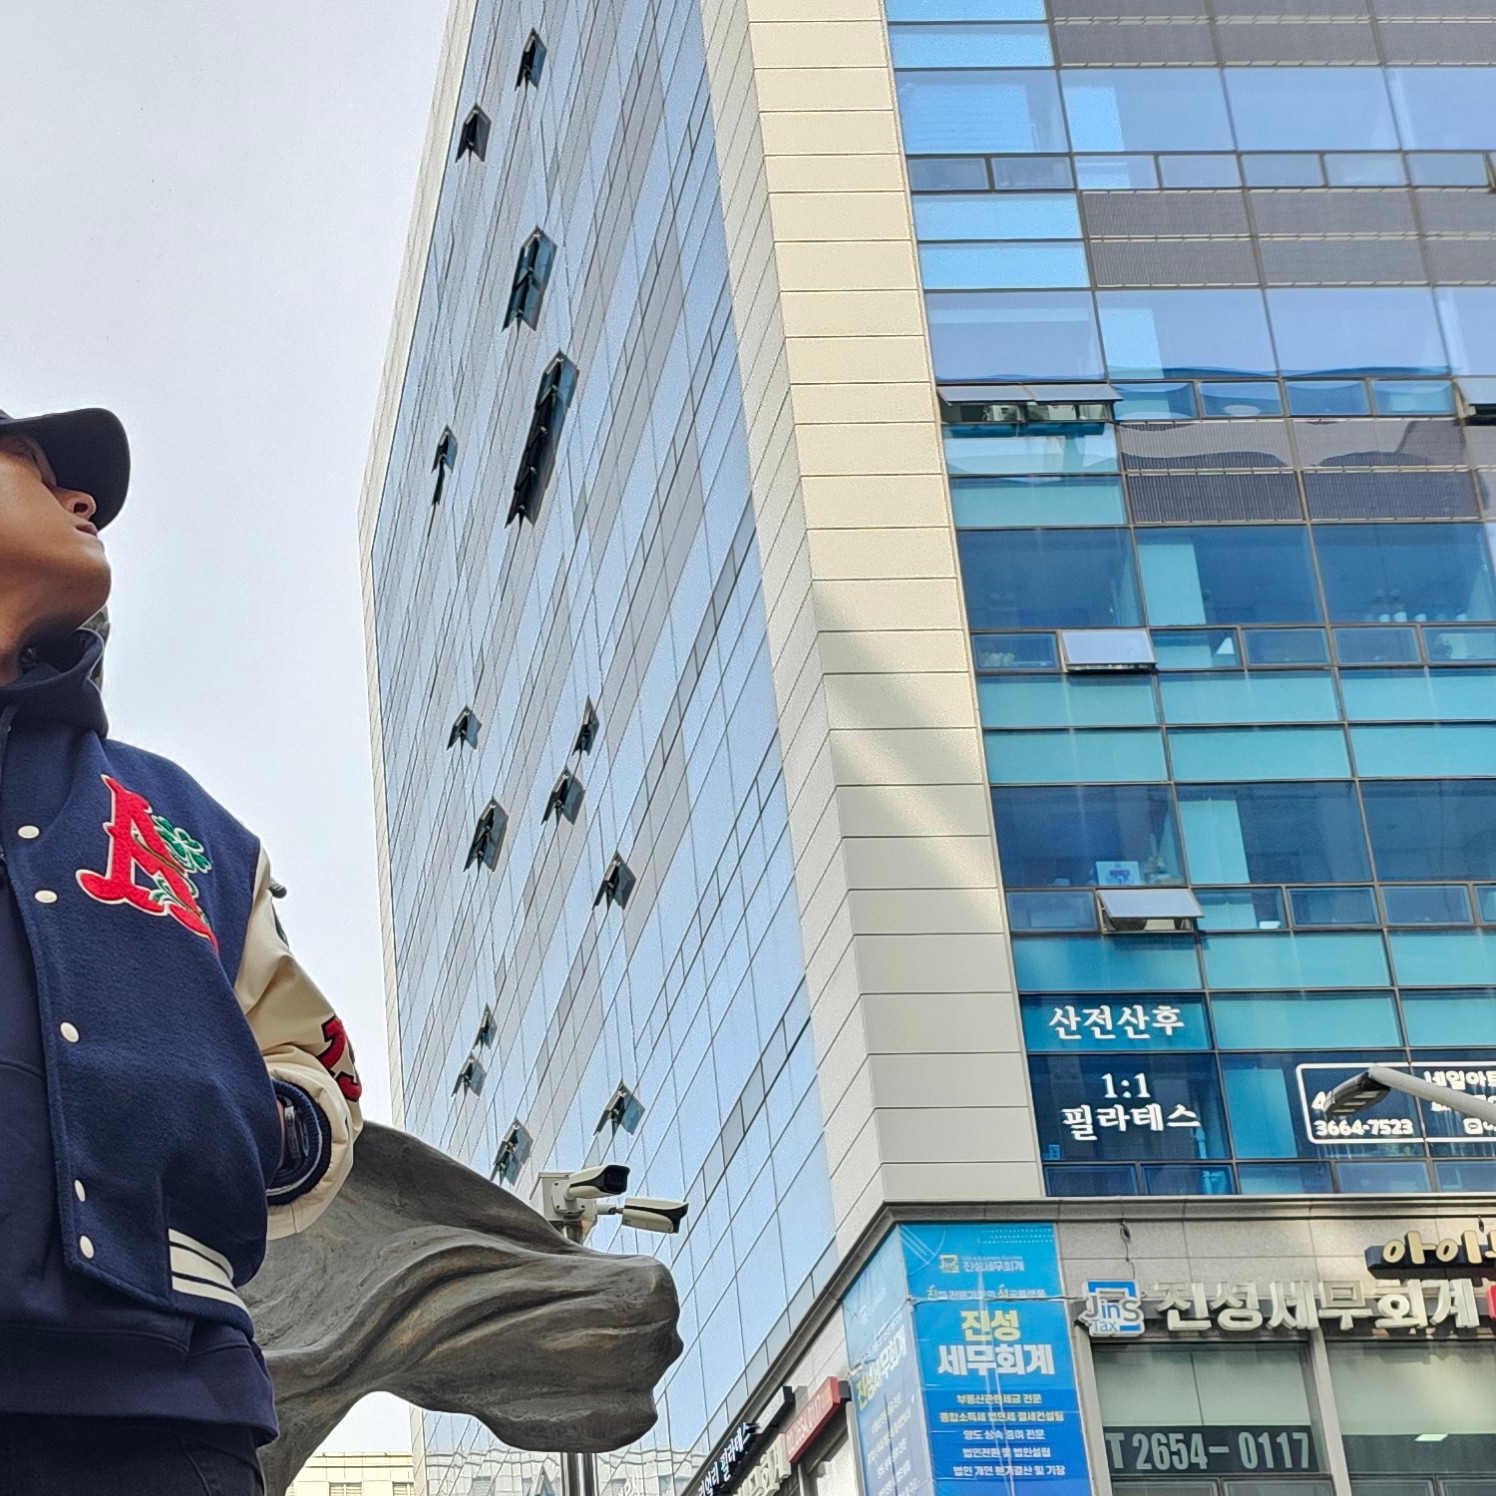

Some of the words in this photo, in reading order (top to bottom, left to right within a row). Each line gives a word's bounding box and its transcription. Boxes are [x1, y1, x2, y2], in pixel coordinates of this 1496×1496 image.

[1049, 1004, 1185, 1040] 산전산후
[1100, 1072, 1152, 1099] 1:1
[1060, 1103, 1202, 1141] 필라테스
[1313, 1118, 1414, 1137] 3664-7523
[1154, 1279, 1480, 1331] 진성세무회계
[960, 1309, 1021, 1342] 진성
[938, 1343, 1055, 1376] 세무회계
[1105, 1432, 1125, 1469] T
